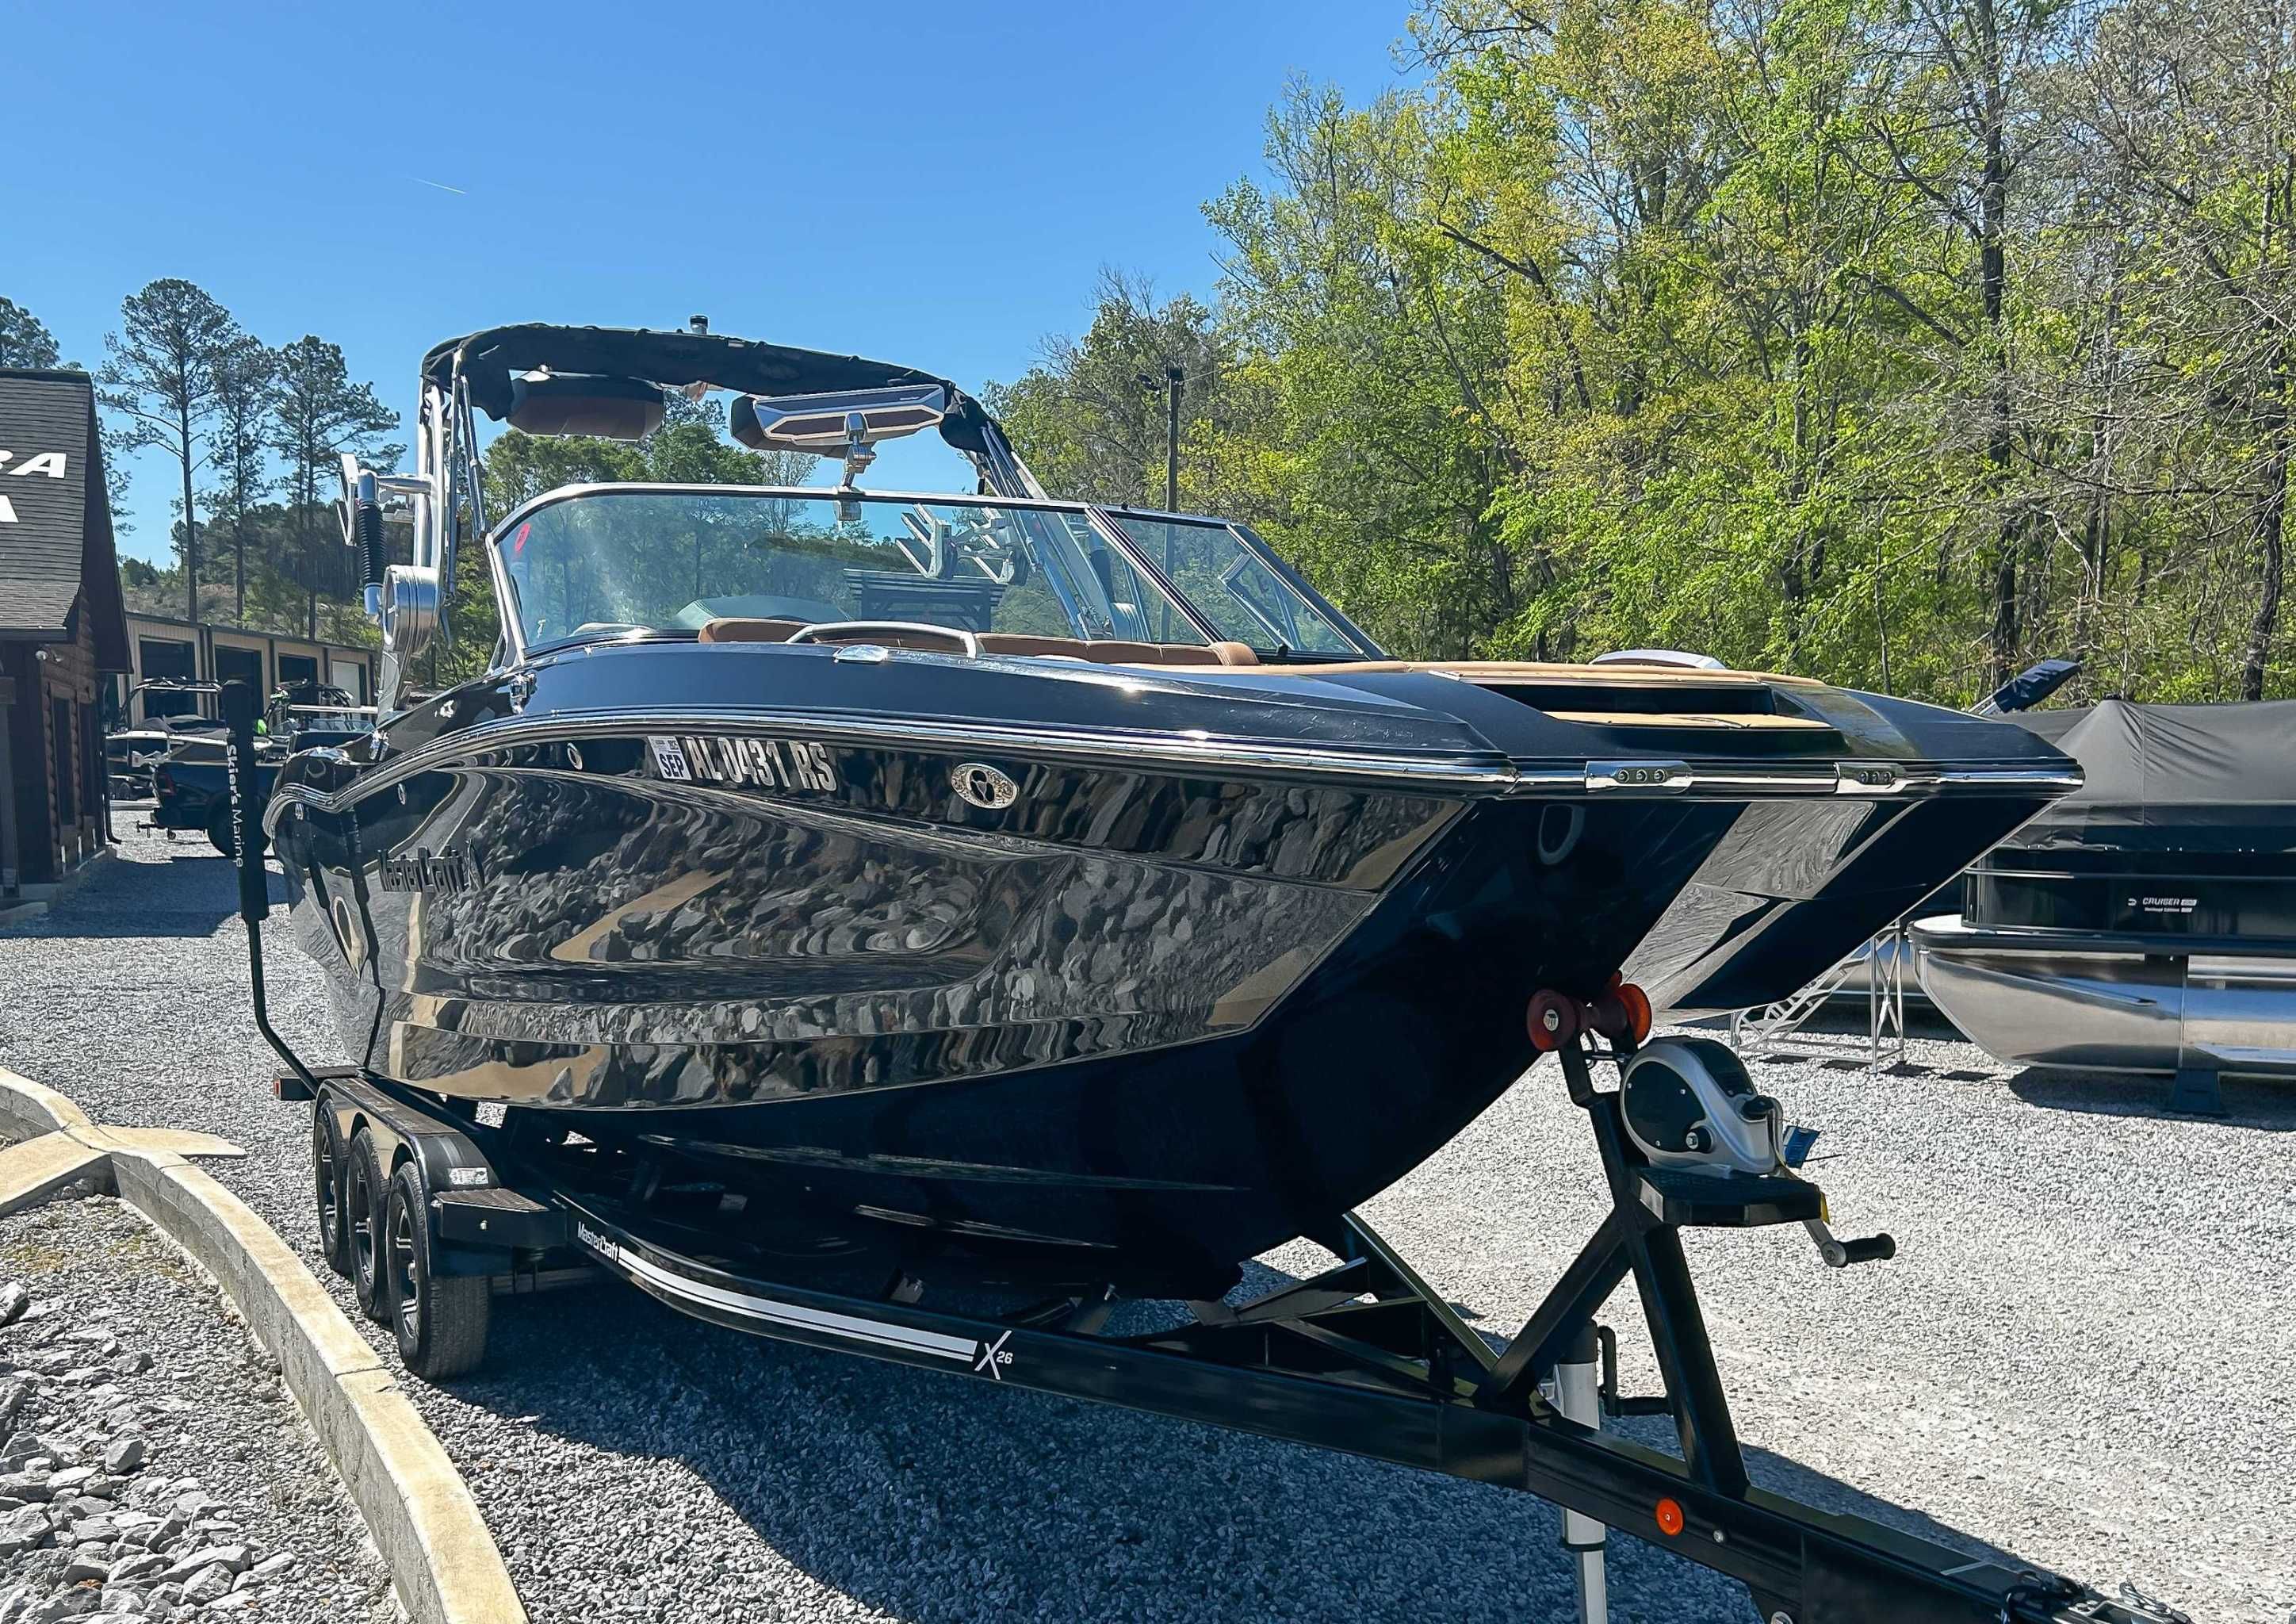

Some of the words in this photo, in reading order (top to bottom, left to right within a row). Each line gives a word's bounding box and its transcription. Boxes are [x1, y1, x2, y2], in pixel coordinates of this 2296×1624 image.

[227, 745, 241, 805] Skier's
[659, 753, 685, 778] SEP
[685, 736, 723, 780] AL
[718, 737, 790, 787] 0431
[788, 740, 837, 791] RS
[232, 809, 245, 868] Marine
[577, 1221, 618, 1262] MasterCraft
